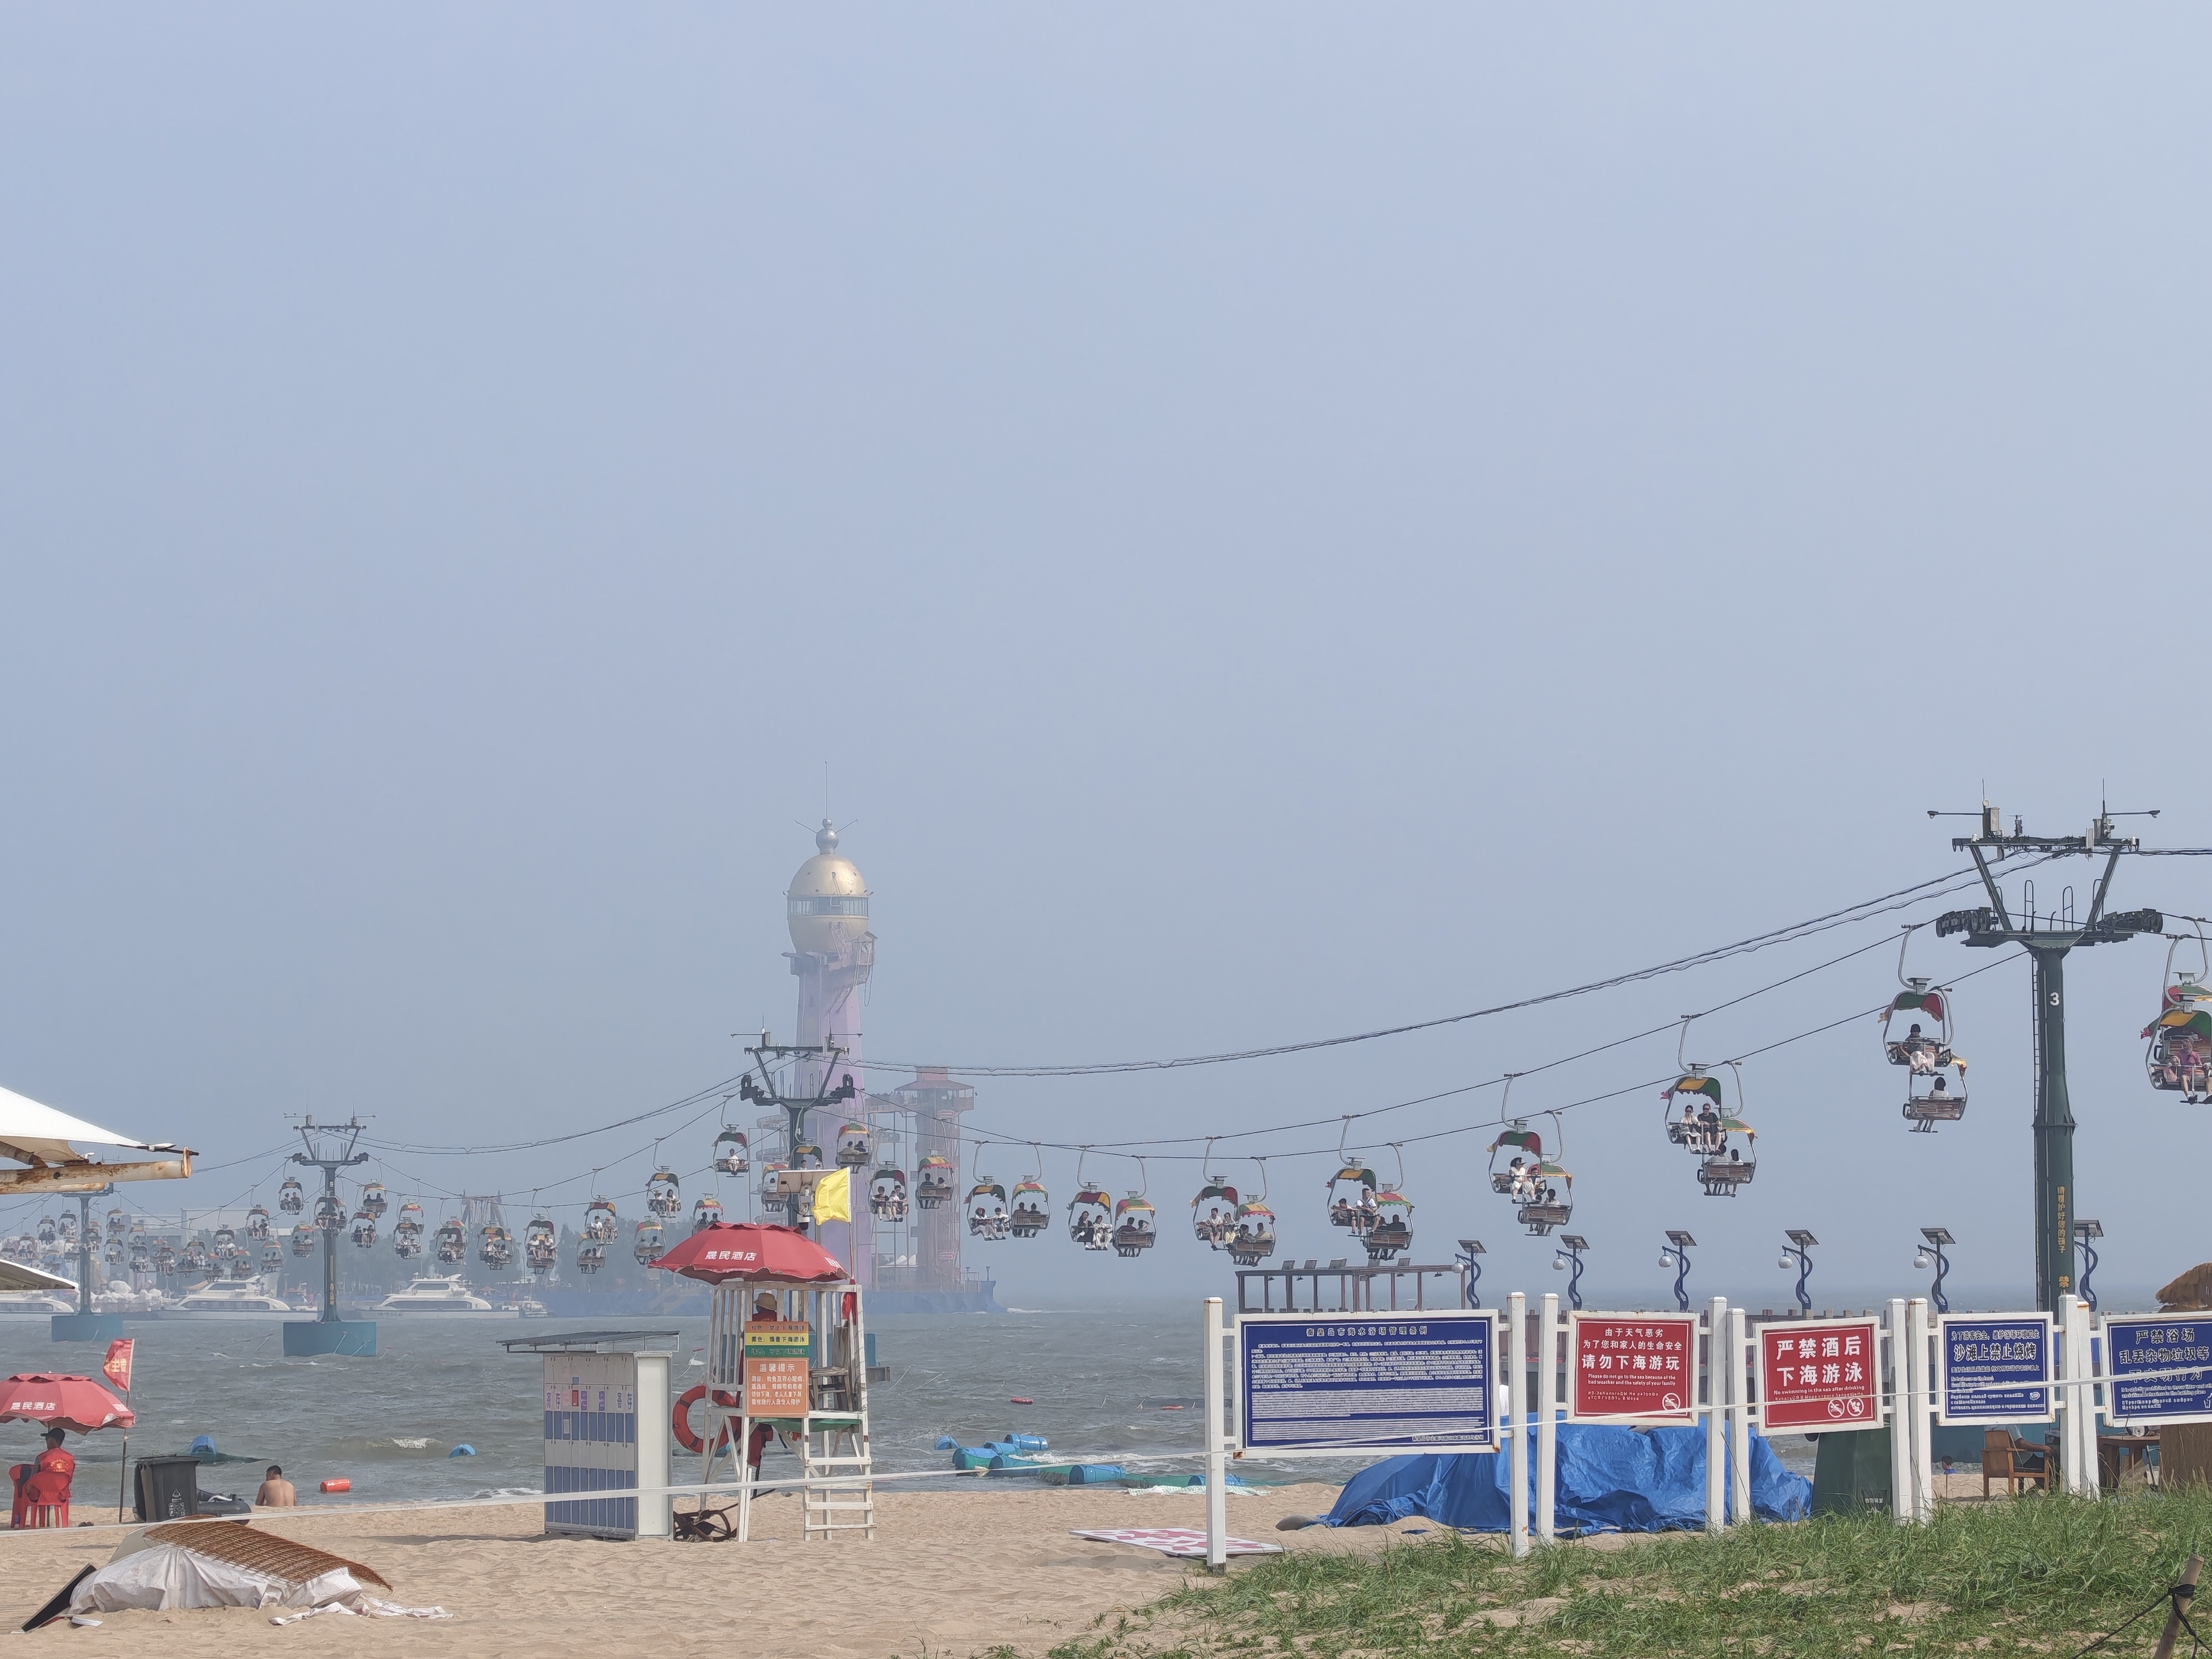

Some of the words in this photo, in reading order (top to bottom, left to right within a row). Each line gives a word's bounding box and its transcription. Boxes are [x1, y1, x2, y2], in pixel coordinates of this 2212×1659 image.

[2049, 992, 2060, 1006] 3
[1306, 1325, 1427, 1337] 秦皇岛市海水浴场管理条例
[1604, 1327, 1663, 1338] 由于天气恶劣
[2135, 1328, 2195, 1345] 严禁浴场
[1583, 1339, 1683, 1351] 为了您和家人的生命安全
[1776, 1336, 1862, 1360] 严禁酒后
[1953, 1342, 2036, 1361] 沙滩上禁止烧烤
[1581, 1353, 1680, 1371] 请勿下海游玩
[2119, 1346, 2210, 1364] 乱丢杂物垃圾等
[759, 1363, 795, 1372] 温馨提示
[1777, 1361, 1863, 1386] 下海游泳
